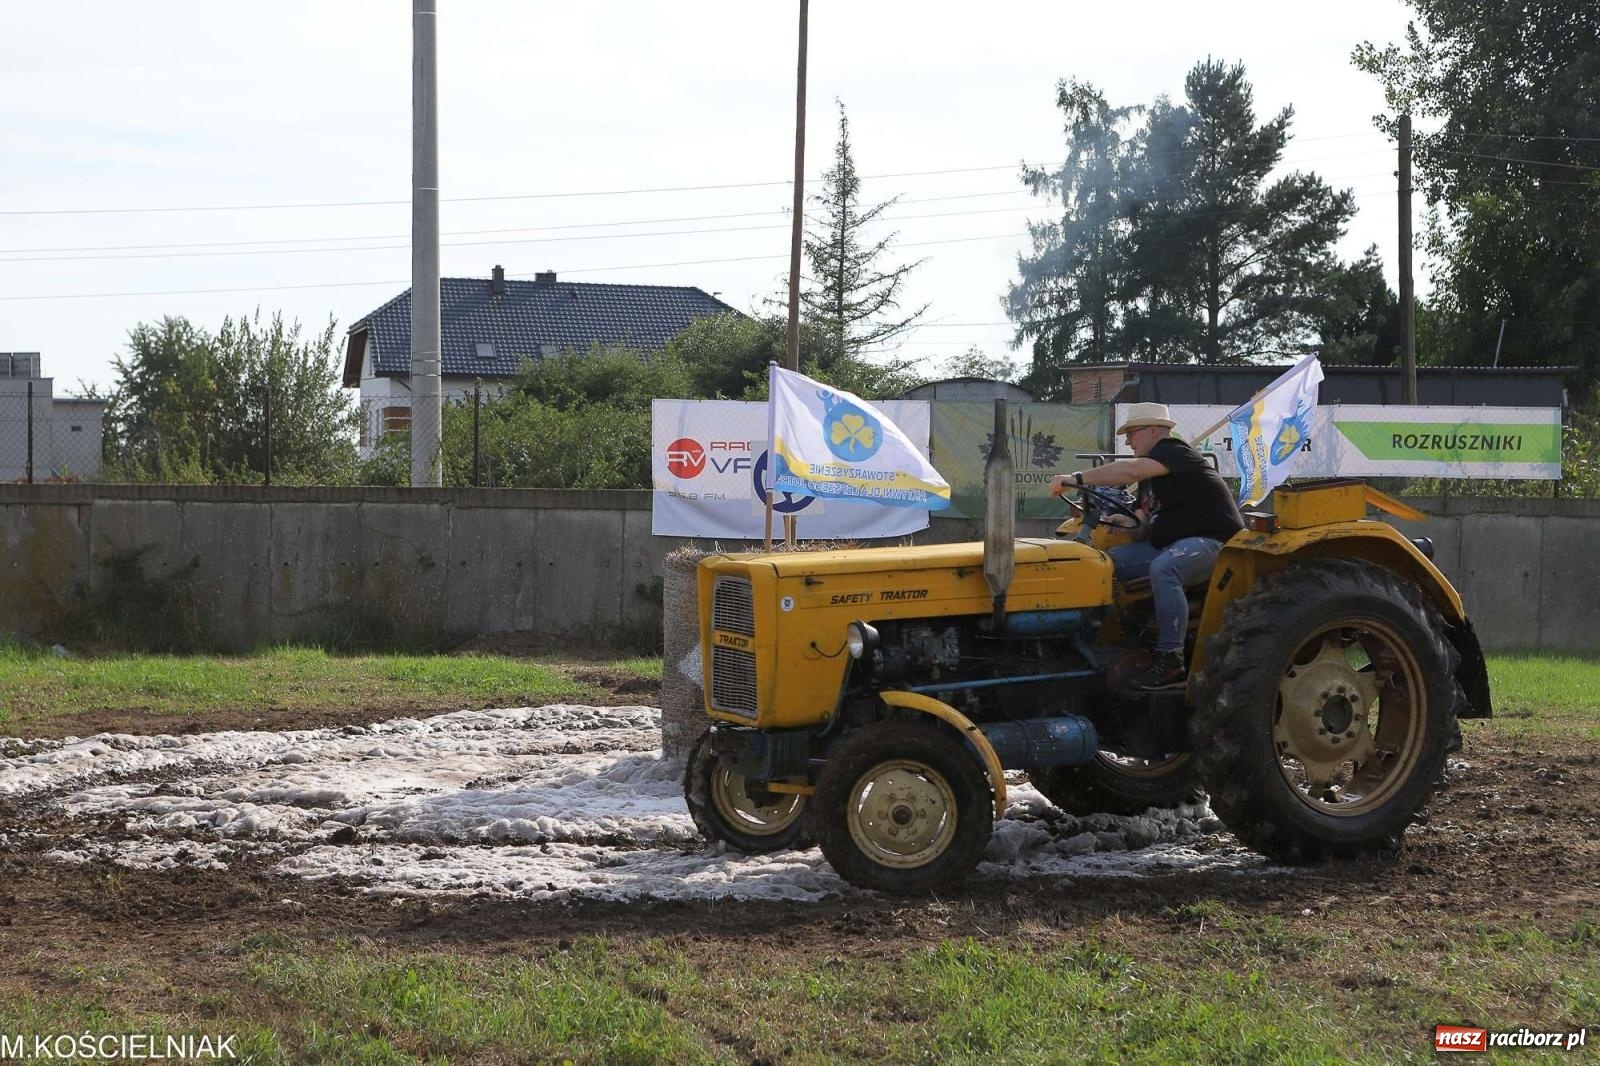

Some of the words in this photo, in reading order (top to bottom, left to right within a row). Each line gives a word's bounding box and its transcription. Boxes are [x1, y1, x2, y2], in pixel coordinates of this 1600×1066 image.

[1392, 434, 1522, 451] ROZRUSZNIKI
[830, 592, 874, 605] SAFETY
[879, 589, 929, 601] TRAKTOR
[719, 634, 749, 648] TRAKTOR
